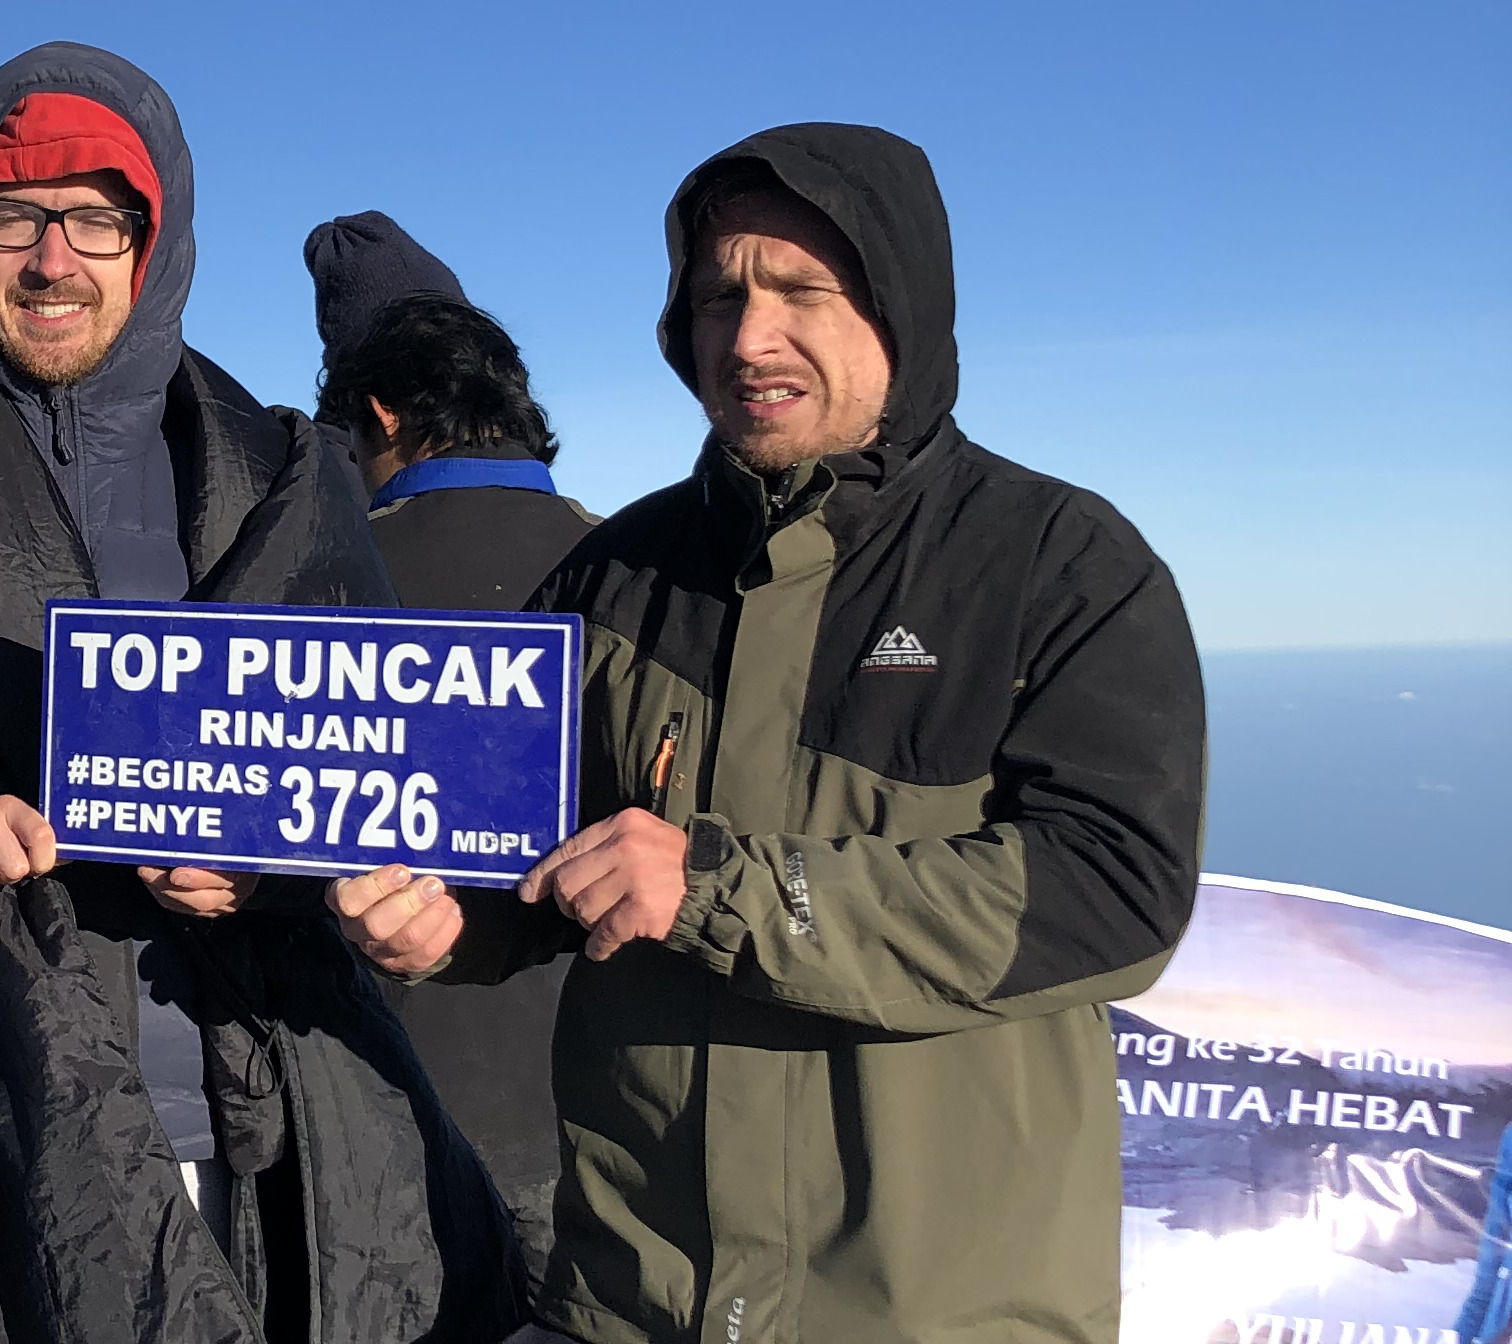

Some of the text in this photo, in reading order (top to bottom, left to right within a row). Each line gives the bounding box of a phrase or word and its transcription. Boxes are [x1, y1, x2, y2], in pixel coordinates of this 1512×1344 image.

[70, 631, 546, 709] TOP PUNCAK
[199, 708, 407, 755] RINJANI
[67, 754, 270, 796] #BEGIRAS
[65, 797, 223, 839] #PENYE
[277, 765, 541, 858] 3726 MDPL
[1185, 1030, 1239, 1061] ke
[1313, 1038, 1449, 1081] Tahun
[1288, 1088, 1475, 1140] HEBAT
